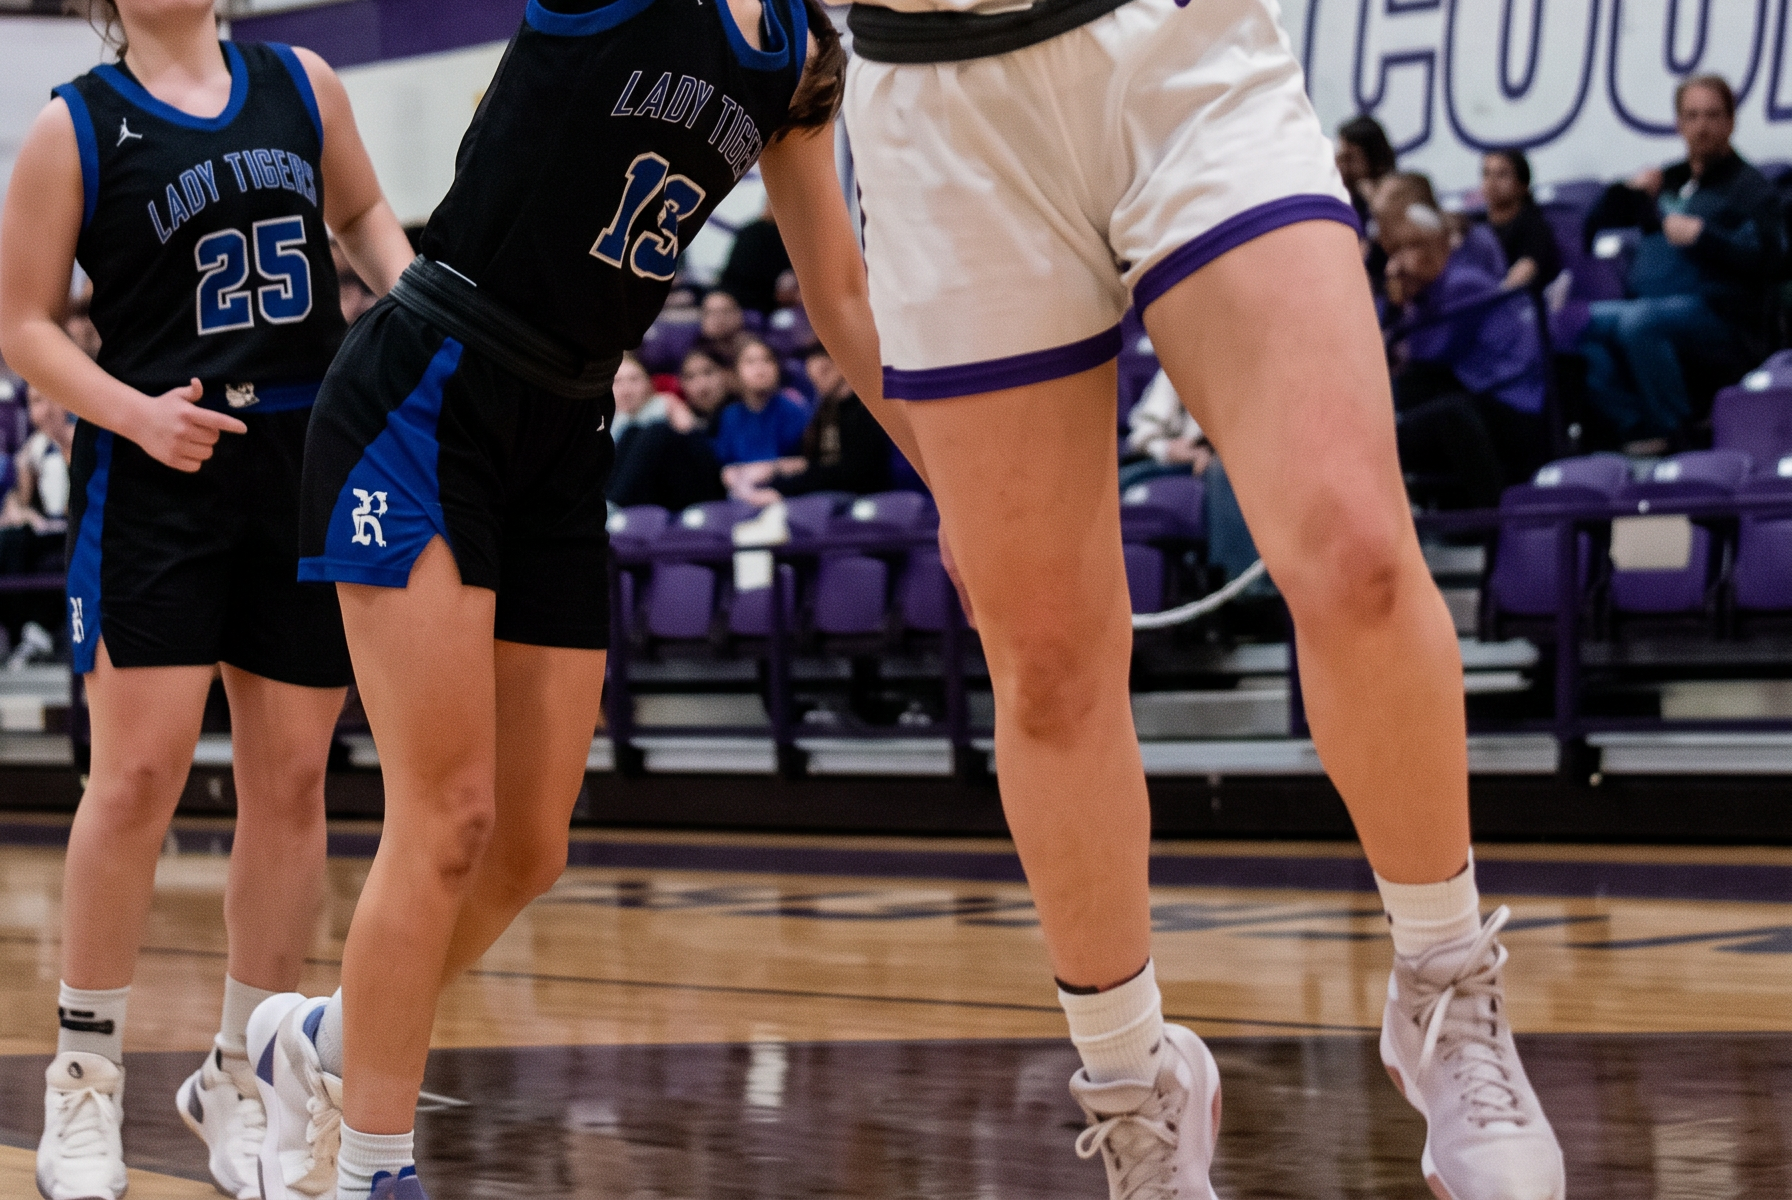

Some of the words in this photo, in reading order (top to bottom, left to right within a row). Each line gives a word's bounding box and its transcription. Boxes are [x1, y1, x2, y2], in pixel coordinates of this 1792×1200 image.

[609, 70, 714, 129] LADY
[148, 160, 220, 245] LADY
[223, 148, 317, 208] TIGERS
[588, 151, 706, 281] 13
[194, 215, 312, 336] 25
